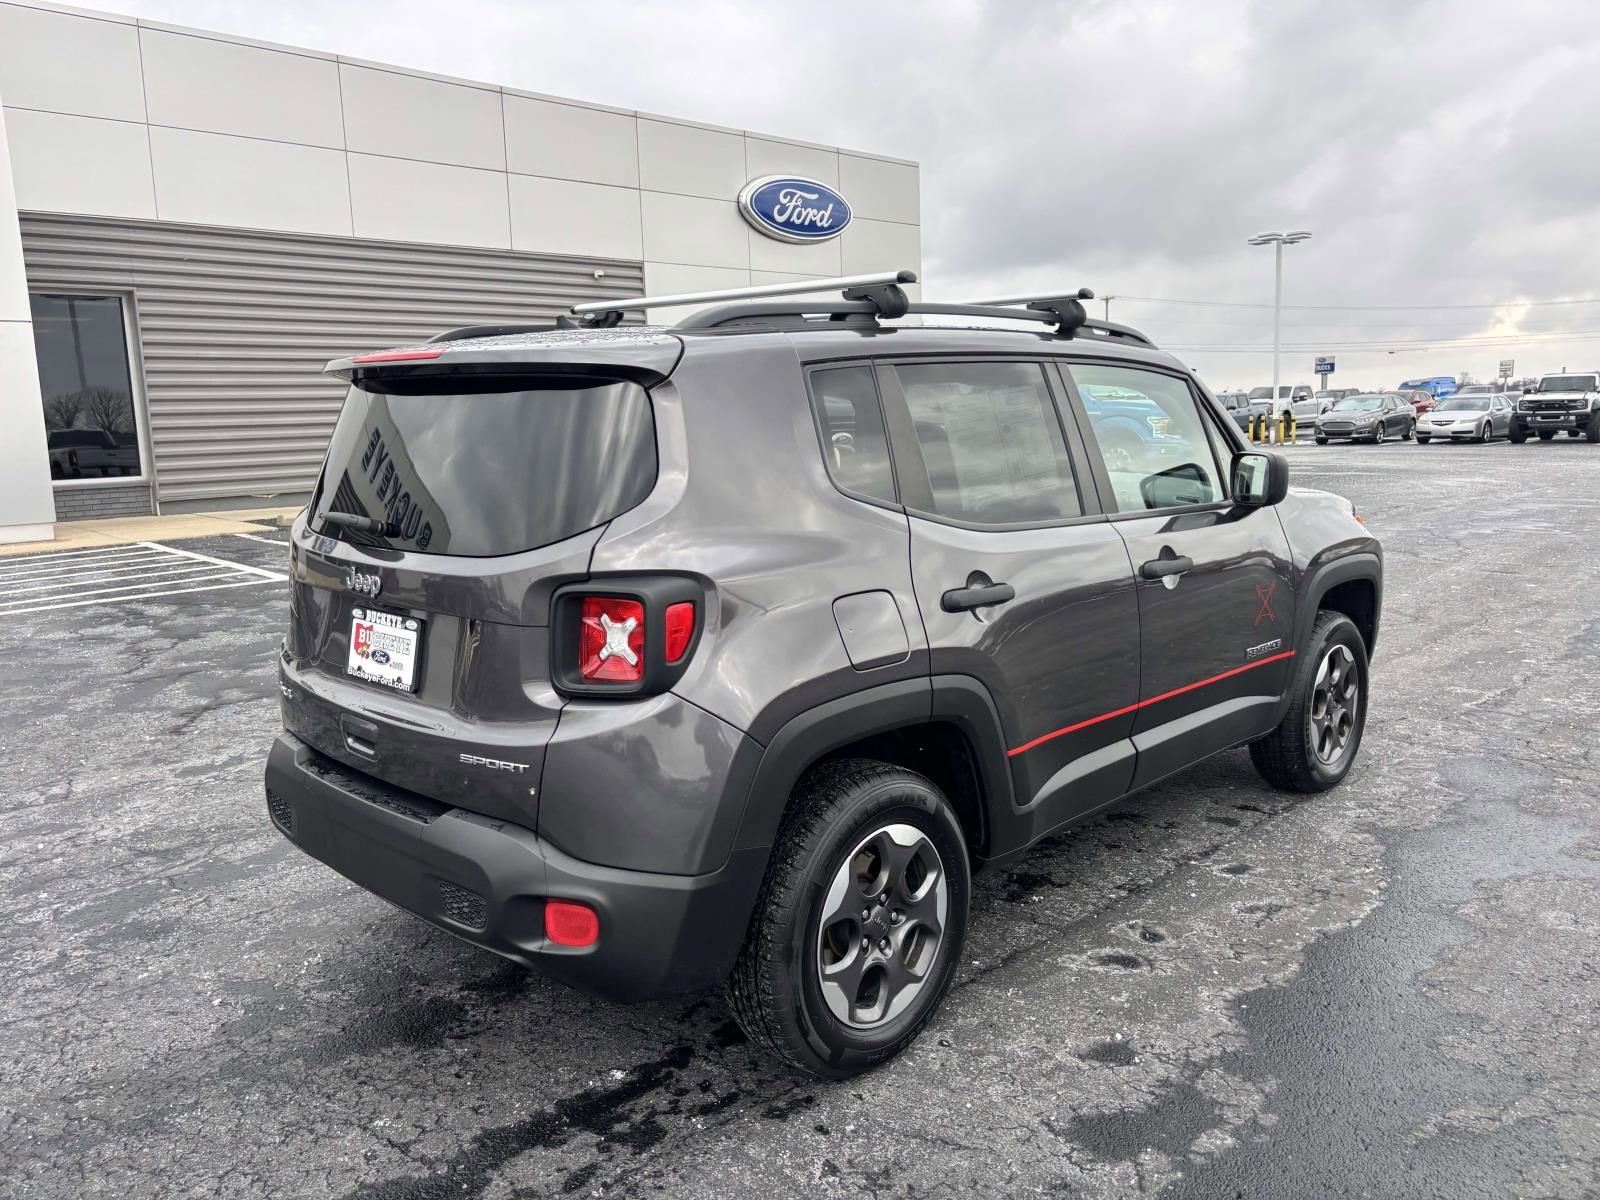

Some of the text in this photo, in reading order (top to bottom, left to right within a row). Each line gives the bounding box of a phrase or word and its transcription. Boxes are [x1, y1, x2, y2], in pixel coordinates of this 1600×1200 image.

[773, 188, 834, 228] Ford
[345, 566, 382, 598] Jeep
[365, 609, 403, 629] BUCKEYE
[358, 628, 412, 656] BUCKEYE
[373, 650, 388, 664] Ford
[347, 666, 410, 692] BuckeyeFord.com
[459, 753, 530, 774] SPORT
